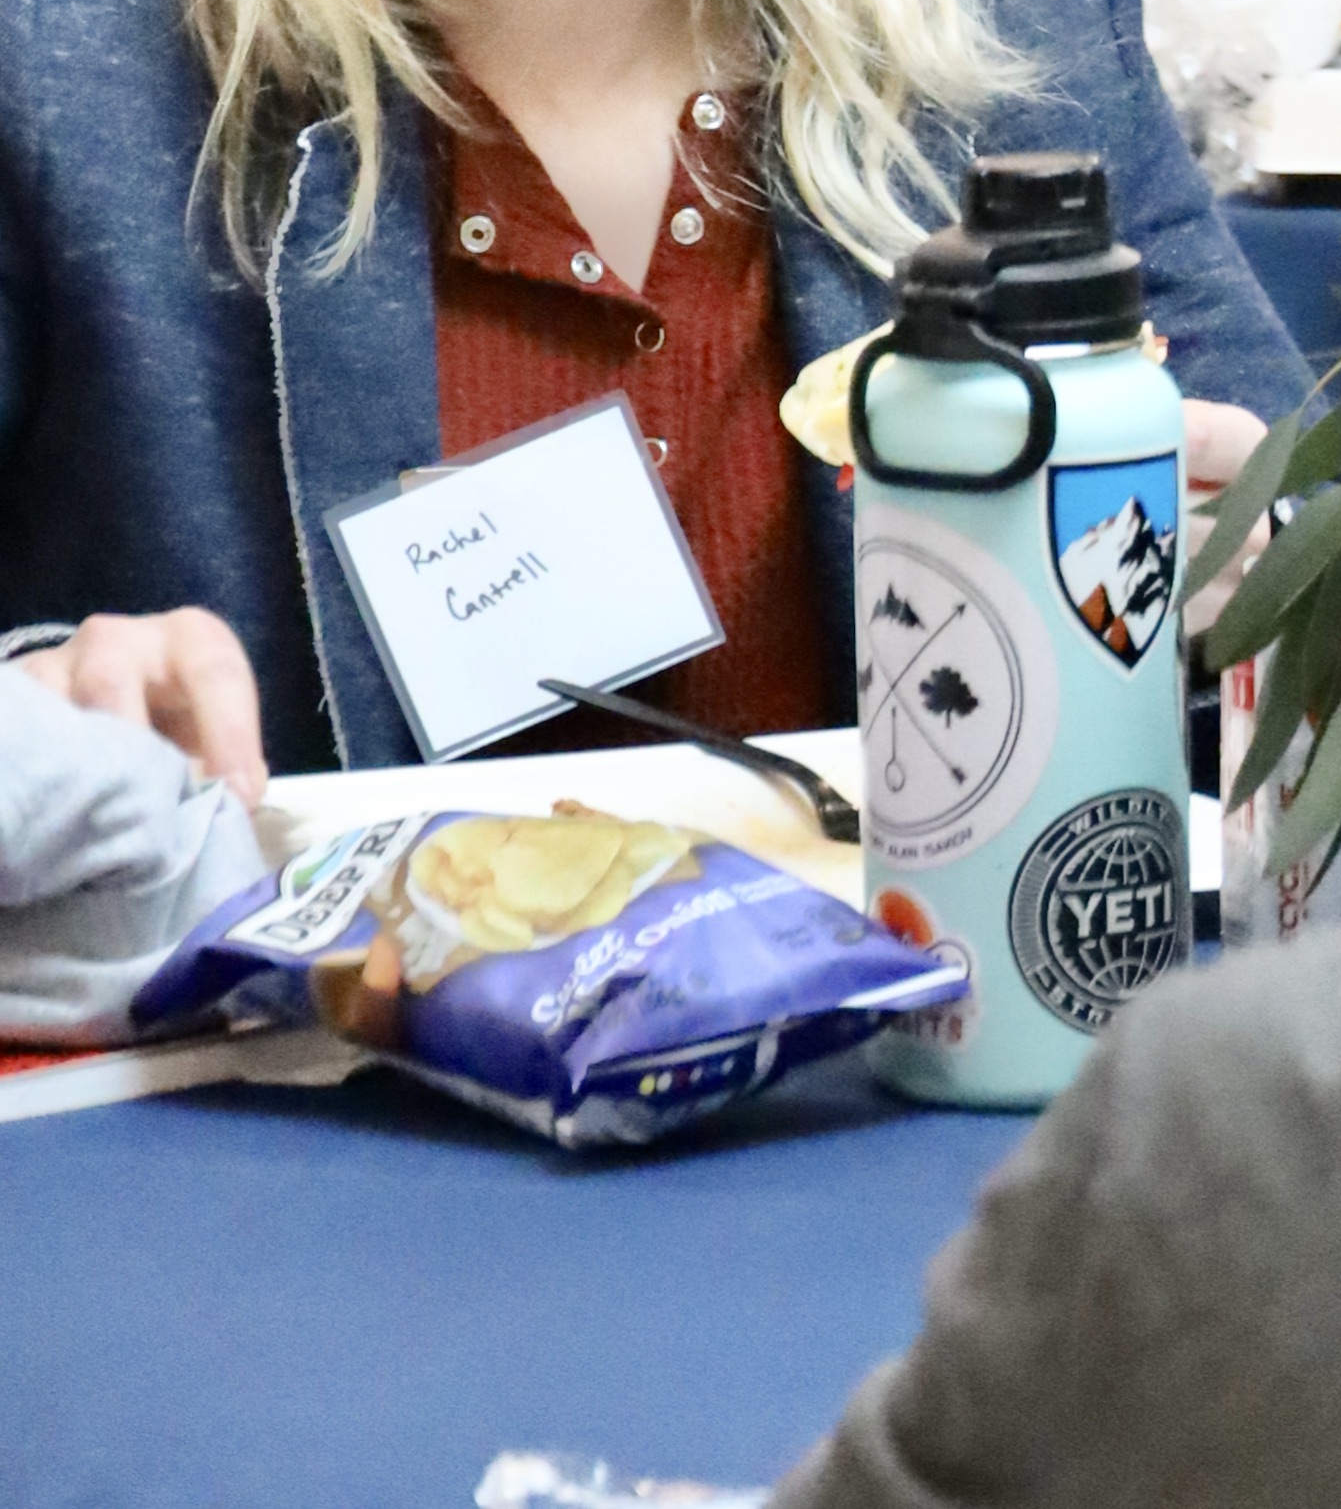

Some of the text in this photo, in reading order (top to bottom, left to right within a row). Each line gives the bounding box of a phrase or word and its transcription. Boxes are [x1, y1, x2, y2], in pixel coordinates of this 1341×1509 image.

[405, 511, 498, 575] Rachel
[446, 551, 549, 621] Cantrell
[255, 817, 407, 943] DEEP RI
[1062, 881, 1174, 939] YETI
